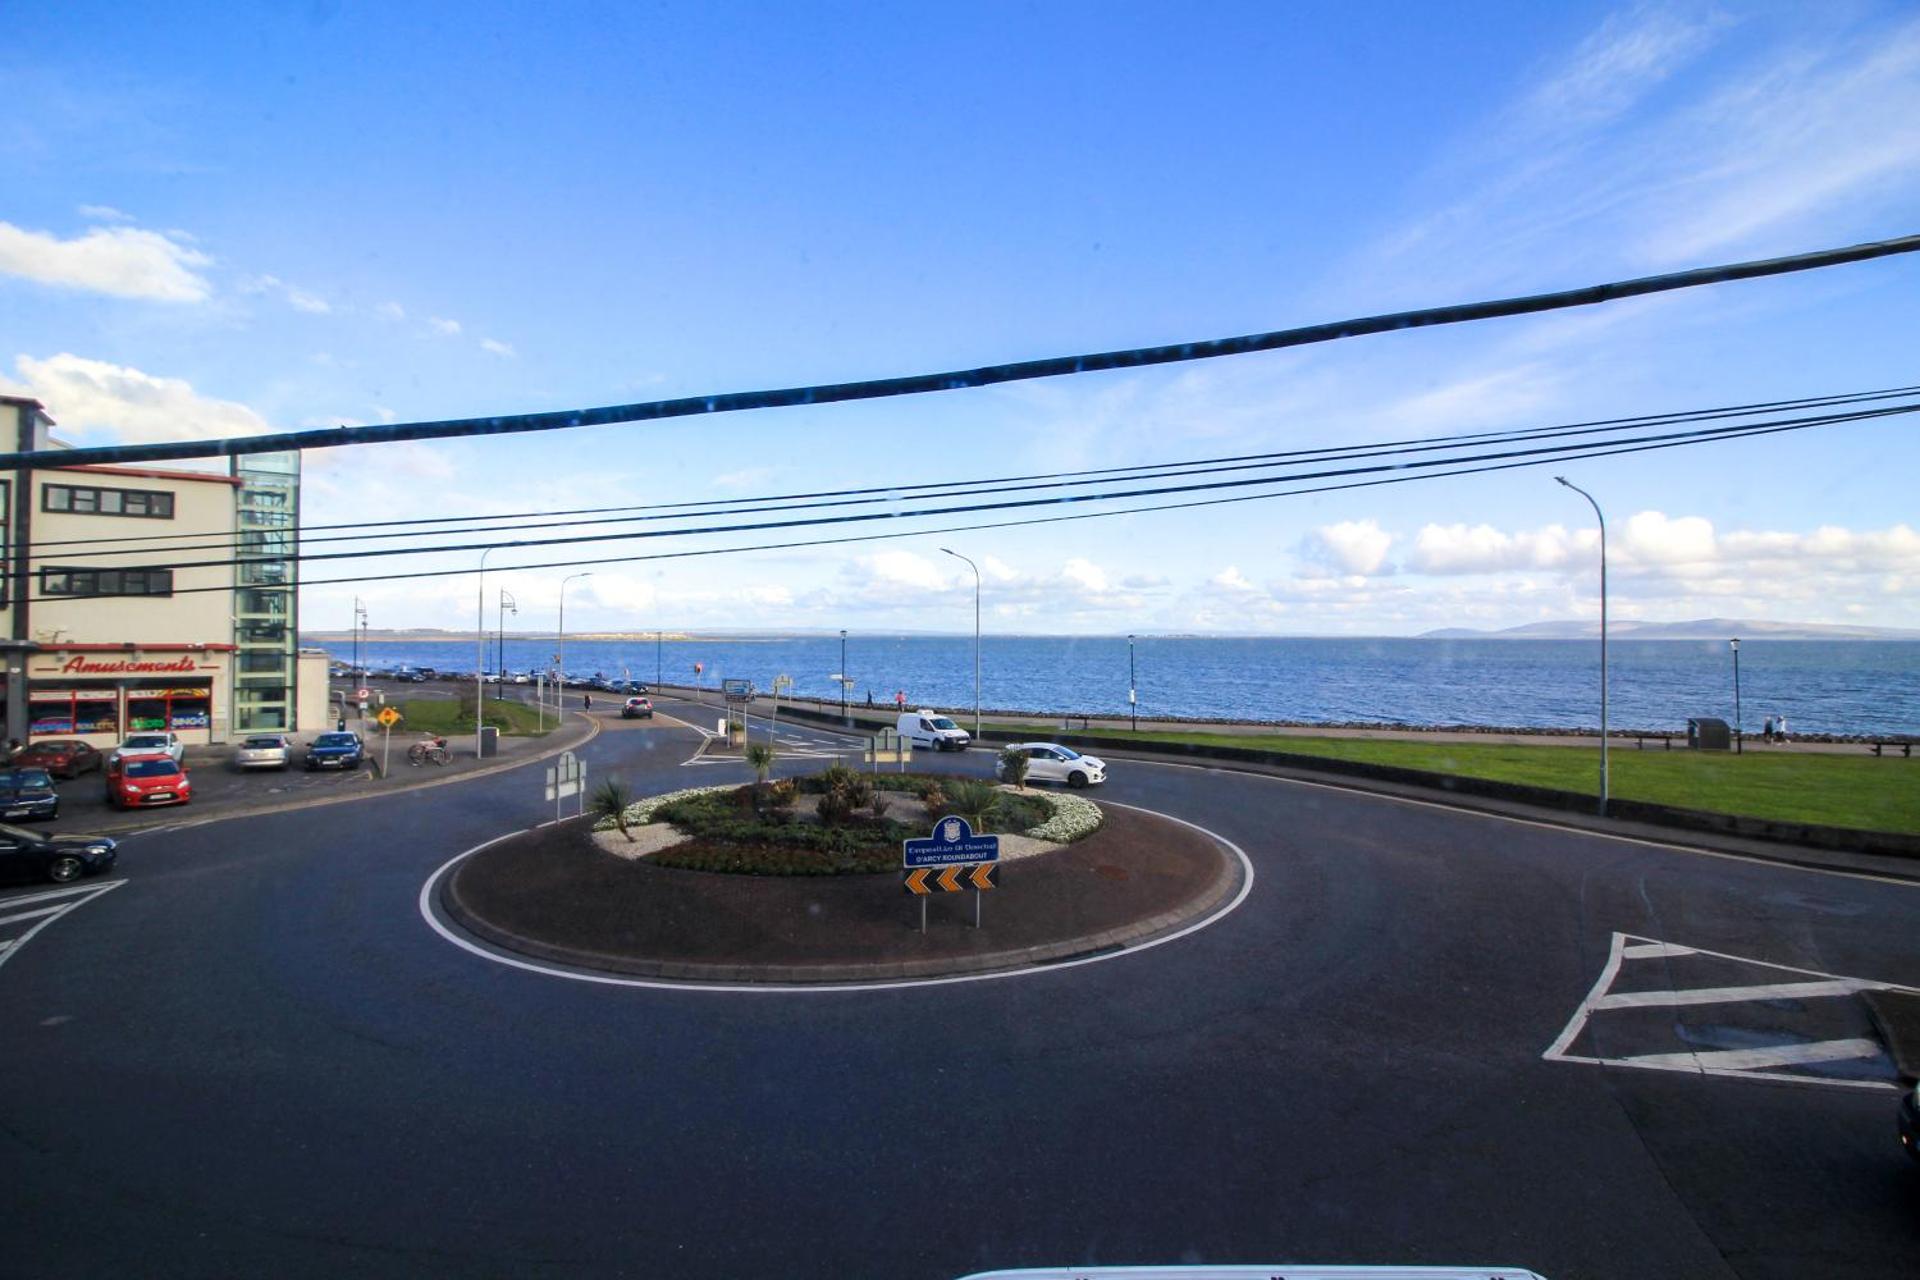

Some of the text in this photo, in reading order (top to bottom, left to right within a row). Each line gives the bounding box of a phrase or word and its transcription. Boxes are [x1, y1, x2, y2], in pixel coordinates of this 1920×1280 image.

[63, 655, 195, 673] Amusements
[172, 717, 207, 727] BINGO
[915, 852, 987, 863] D'ARCY ROUNDABOUT
